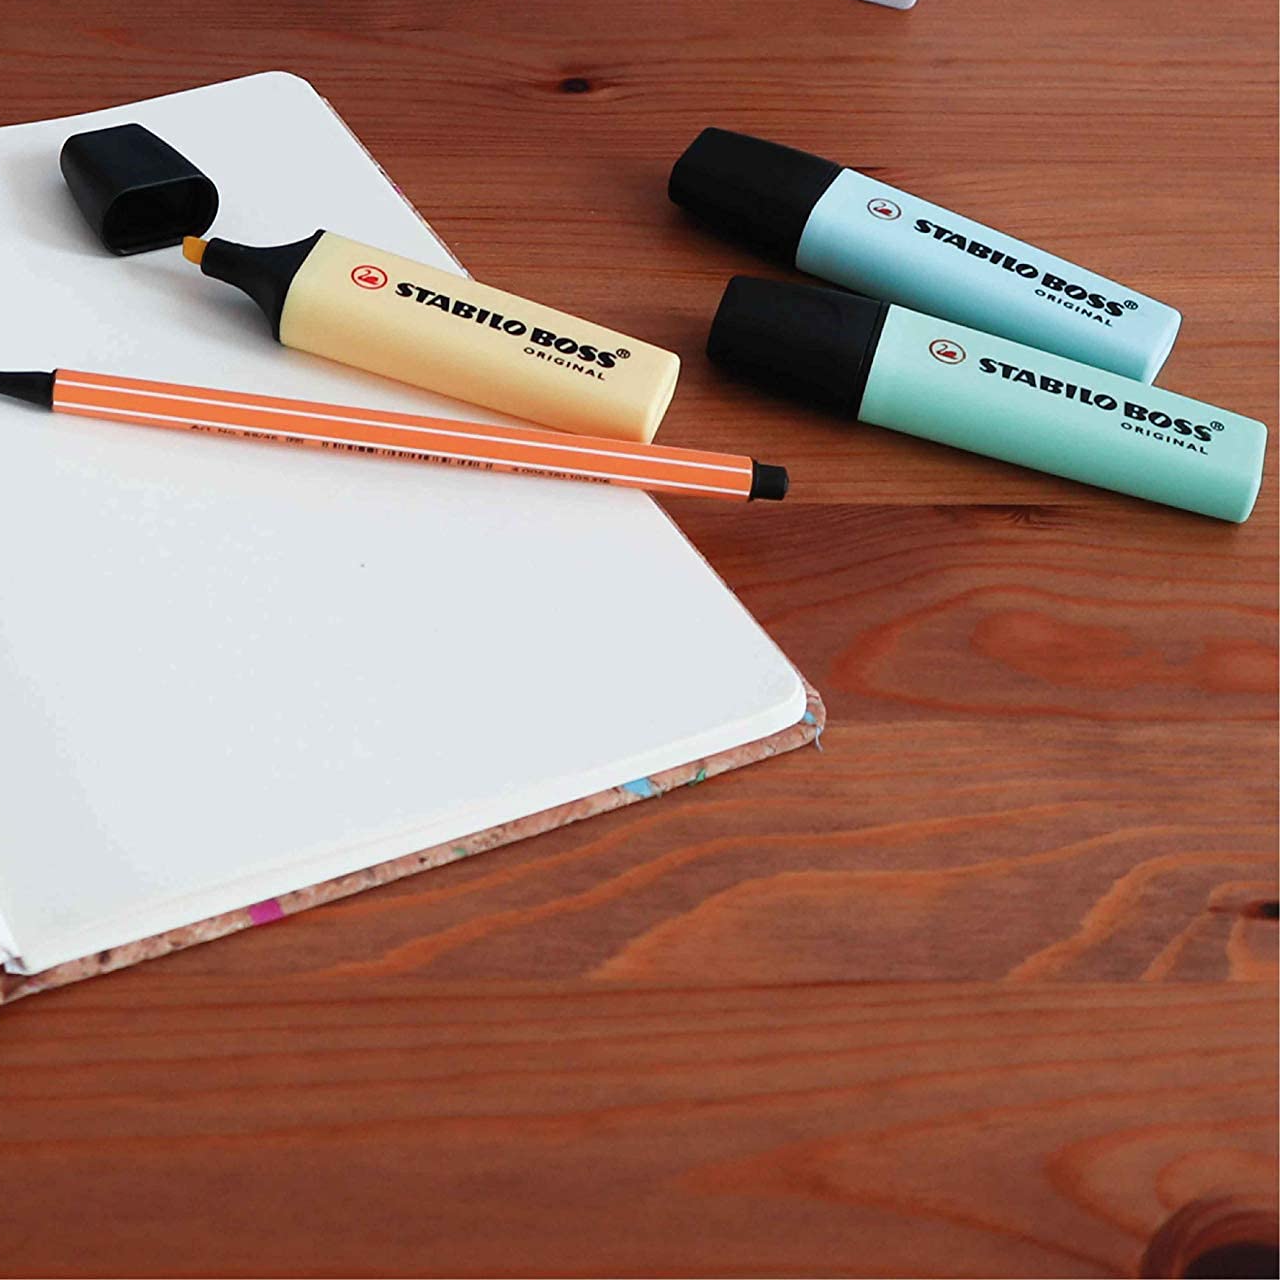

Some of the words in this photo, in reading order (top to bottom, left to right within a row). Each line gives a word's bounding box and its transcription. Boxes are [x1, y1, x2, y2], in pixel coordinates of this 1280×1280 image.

[912, 217, 1039, 281] STABILO
[394, 281, 528, 338] STABILO
[1034, 288, 1115, 328] ORIGINAL
[523, 346, 606, 381] ORIGINAL
[978, 356, 1119, 412] STABILO
[1120, 421, 1210, 456] ORIGINAL
